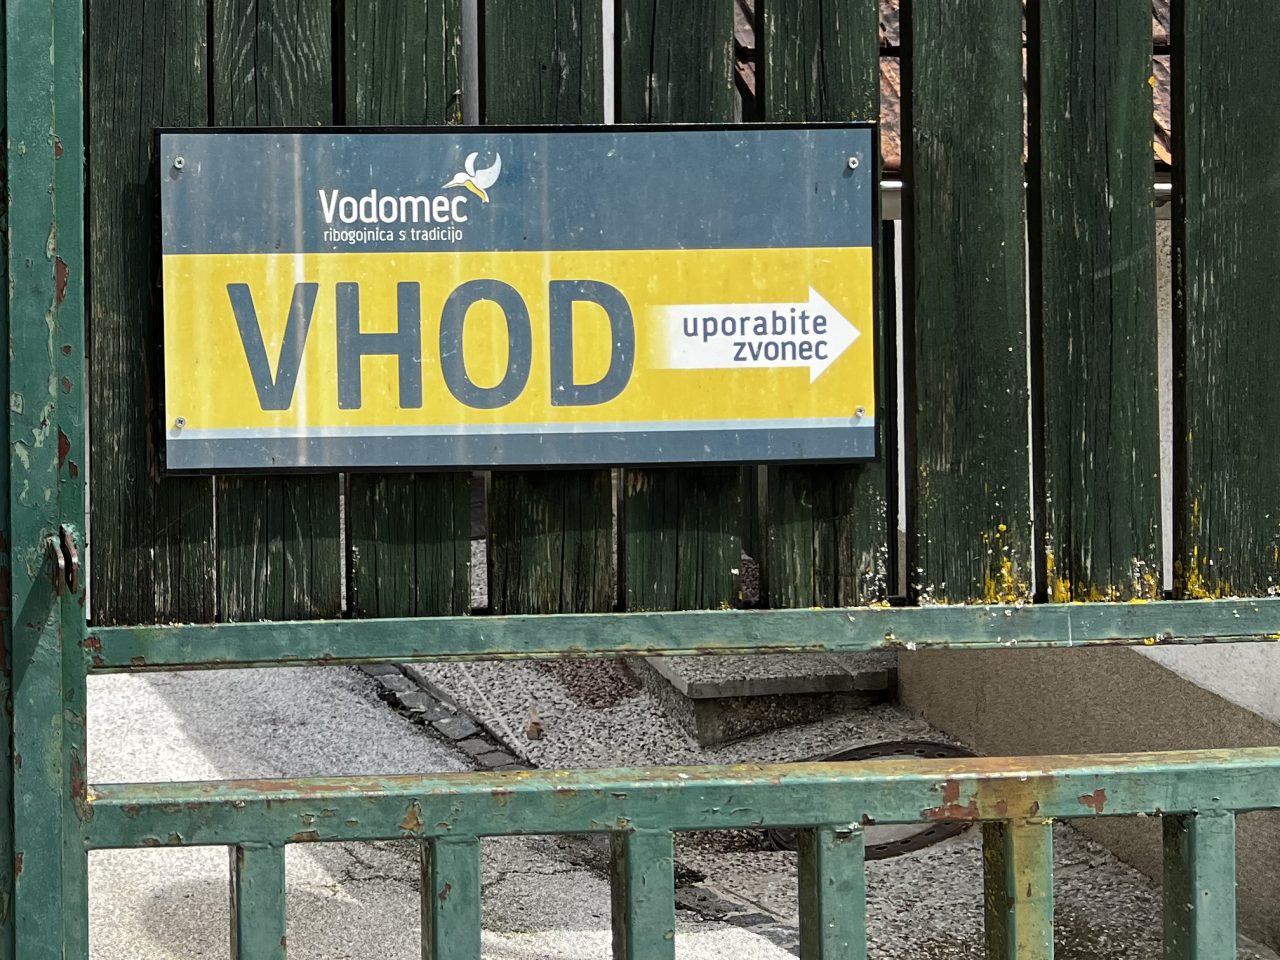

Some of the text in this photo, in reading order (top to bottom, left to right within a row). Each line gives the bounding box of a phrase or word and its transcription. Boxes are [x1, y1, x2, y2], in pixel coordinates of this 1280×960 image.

[319, 189, 468, 224] Vodomec
[323, 226, 463, 245] ribogojnica s tradicijo
[683, 307, 827, 343] uporabite
[226, 278, 636, 411] VHOD
[733, 340, 828, 361] zvonec
